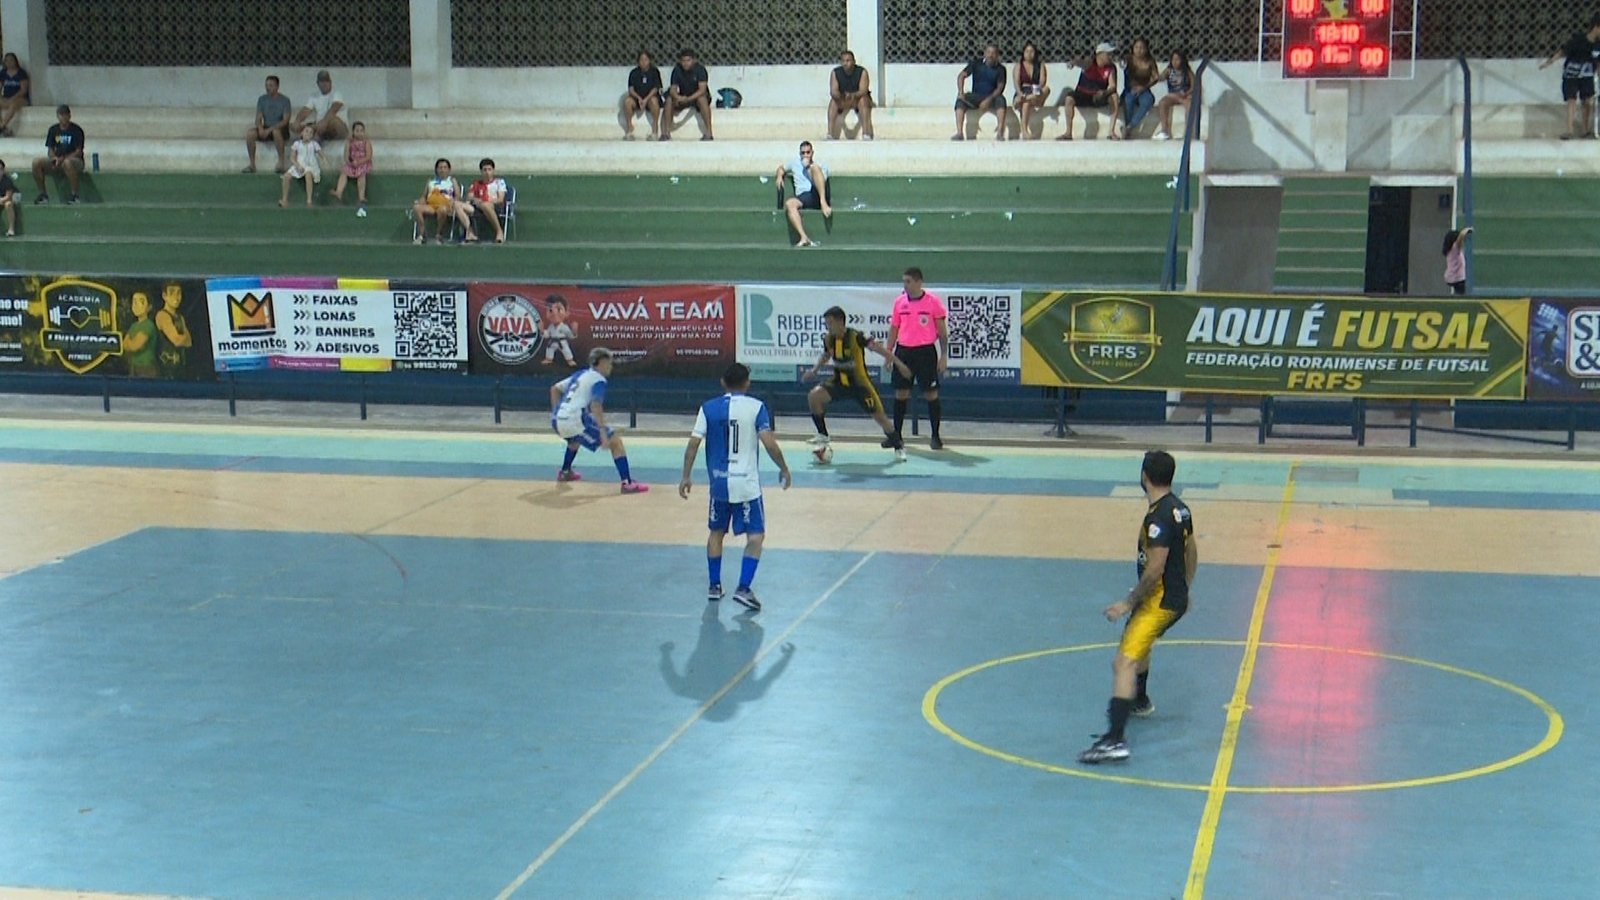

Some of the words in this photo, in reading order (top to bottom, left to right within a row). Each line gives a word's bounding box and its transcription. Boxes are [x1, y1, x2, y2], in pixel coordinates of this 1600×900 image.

[1290, 48, 1314, 68] 00
[1360, 47, 1383, 67] 00
[58, 294, 101, 304] ACADEMIA
[312, 295, 358, 306] FAIXAS
[588, 296, 650, 320] VAVÁ
[655, 301, 725, 320] TEAM
[314, 311, 356, 322] LONAS
[778, 314, 828, 330] RIBEIR
[315, 327, 375, 339] BANNERS
[1185, 307, 1291, 347] AQUI
[1296, 302, 1325, 347] É
[1332, 310, 1490, 351] FUTSAL
[218, 336, 288, 351] momentos
[315, 341, 380, 354] ADESIVOS
[498, 343, 524, 353] TEAM
[1089, 344, 1137, 359] FRFS
[1186, 352, 1283, 369] FEDERAÇÃO
[1288, 354, 1396, 371] RORAIMENSE
[1400, 358, 1422, 371] DE
[1426, 357, 1490, 373] FUTSAL
[963, 369, 1015, 378] 99127-2034
[1287, 371, 1363, 391] FRFS
